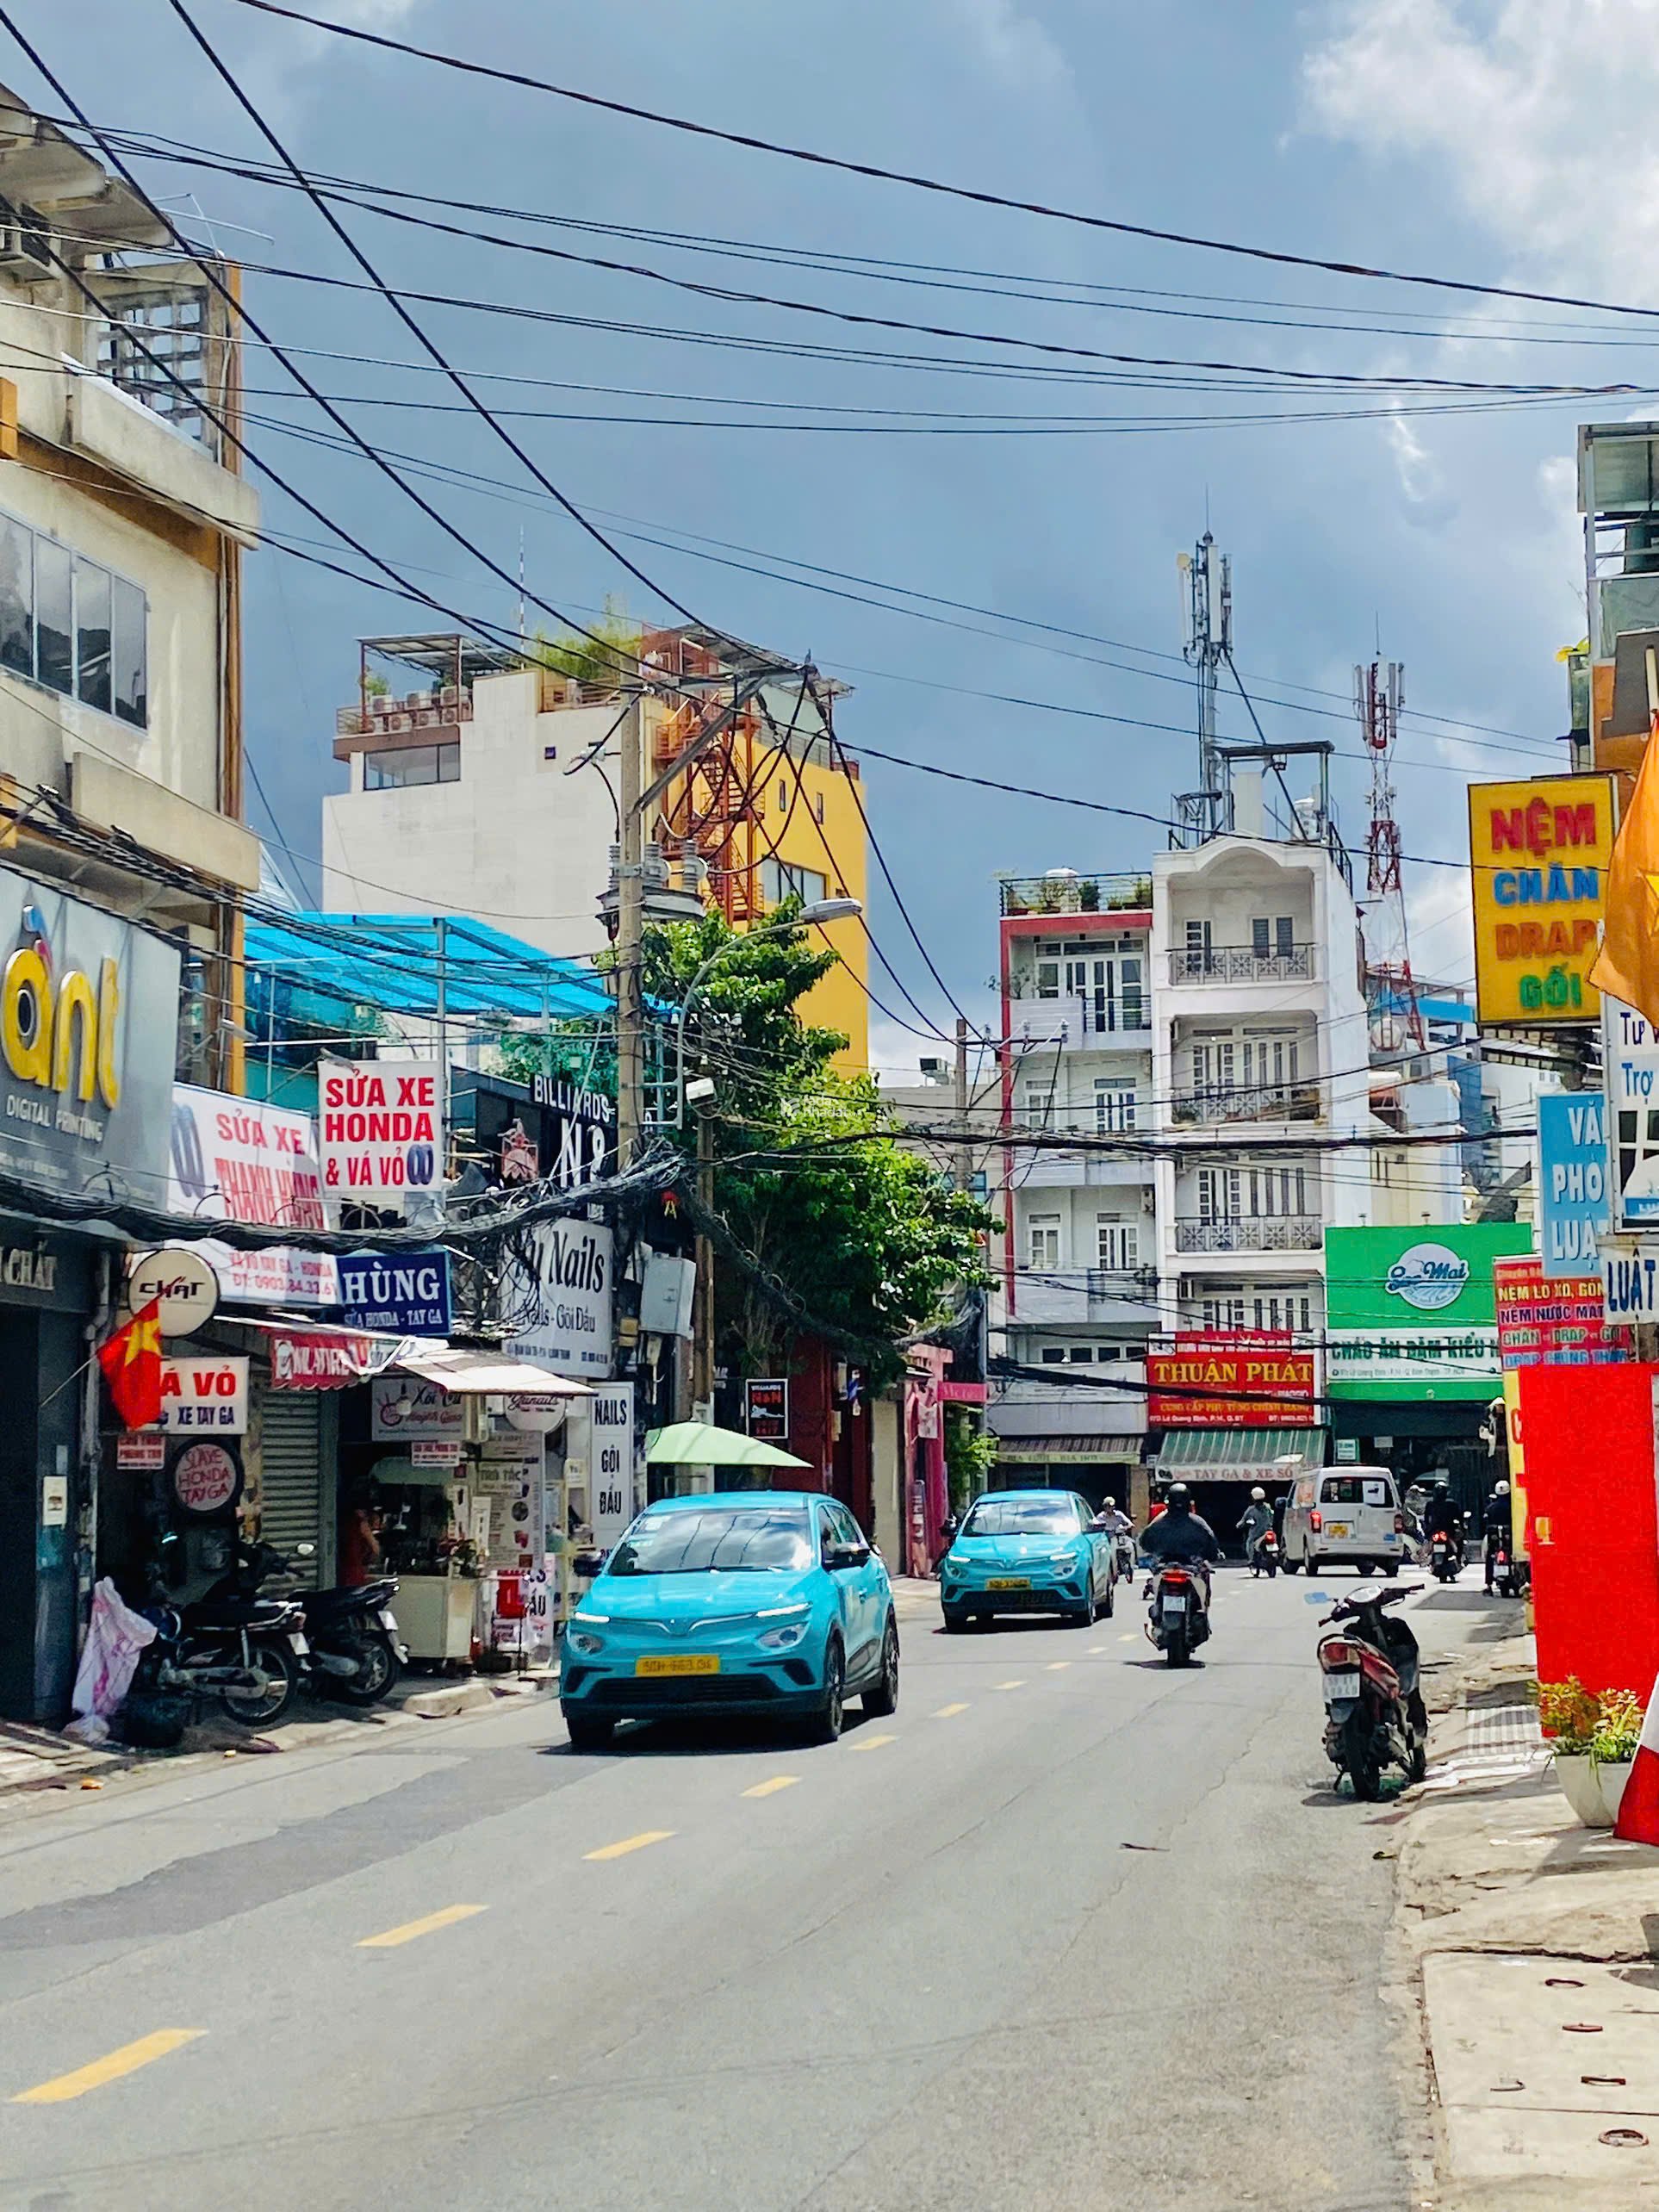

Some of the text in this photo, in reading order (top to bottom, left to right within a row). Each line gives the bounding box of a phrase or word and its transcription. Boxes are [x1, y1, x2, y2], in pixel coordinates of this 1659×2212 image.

[1490, 797, 1596, 856] NỆM
[1494, 919, 1595, 960] DRAP
[1519, 962, 1581, 1010] GỐI
[1619, 1012, 1645, 1045] Tư
[326, 1068, 434, 1108] SỬA XE
[1621, 1062, 1654, 1104] Trợ
[7, 1095, 51, 1128] DIGITAL
[326, 1113, 434, 1142] HONDA
[1568, 1100, 1606, 1146] VĂ
[216, 1109, 306, 1155] SỬA XE
[326, 1146, 404, 1186] & VÁ VỎ
[1552, 1152, 1608, 1203] PHÒ
[343, 1261, 440, 1303] HÙNG
[549, 1231, 605, 1293] Nails
[365, 1312, 400, 1327] HONDA
[407, 1309, 426, 1325] TAY
[428, 1309, 443, 1324] GA
[159, 1364, 236, 1396] Á VỎ
[1154, 1357, 1314, 1387] THUẬN PHÁT
[177, 1406, 193, 1425] XE
[196, 1406, 215, 1425] TAY
[219, 1406, 234, 1425] GA
[594, 1400, 627, 1426] NAILS
[177, 1466, 230, 1488] HONDA
[1194, 1469, 1219, 1479] TAY
[1221, 1469, 1240, 1479] GA
[1256, 1469, 1274, 1479] XE
